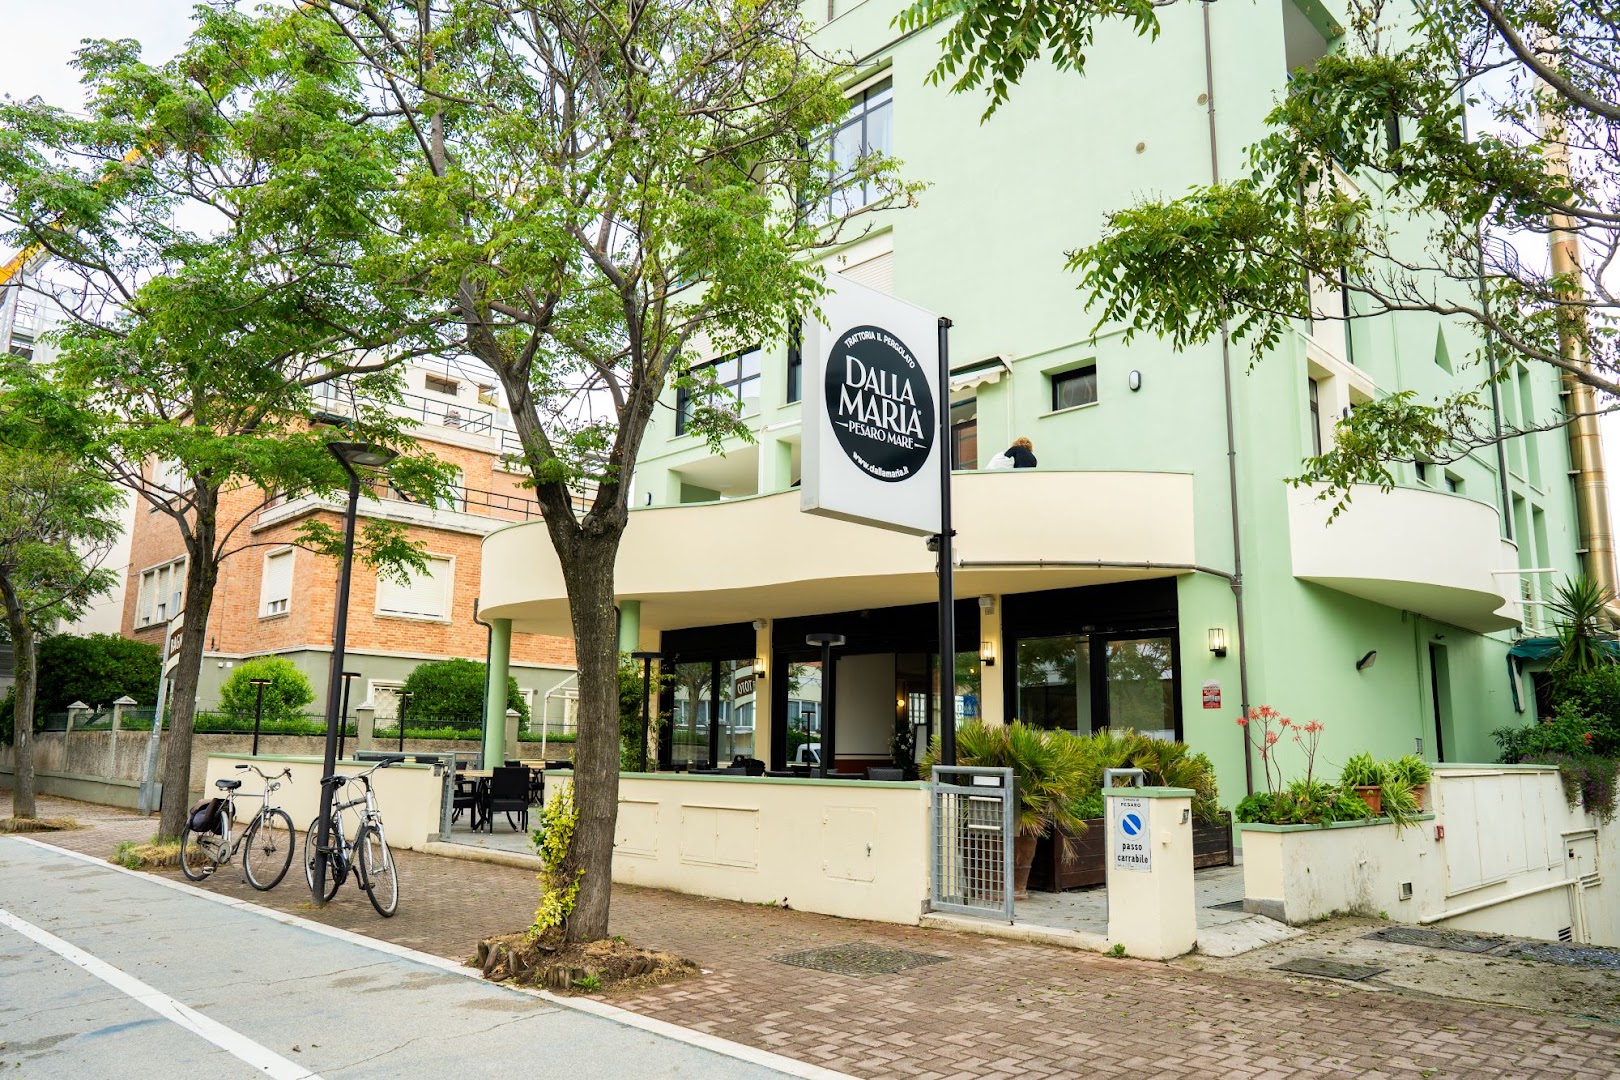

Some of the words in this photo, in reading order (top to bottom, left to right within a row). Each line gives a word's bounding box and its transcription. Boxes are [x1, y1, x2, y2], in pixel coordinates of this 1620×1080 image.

[844, 331, 876, 348] TRATTORIA
[877, 333, 883, 342] IL
[884, 335, 916, 369] PERGOLATO
[846, 355, 916, 406] DALLA
[839, 383, 924, 440] MARIA
[849, 420, 886, 442] PESARO
[887, 432, 914, 450] MARE
[853, 451, 909, 478] www.dallamaria.it
[1117, 854, 1149, 864] carrabile
[1122, 843, 1143, 852] passo
